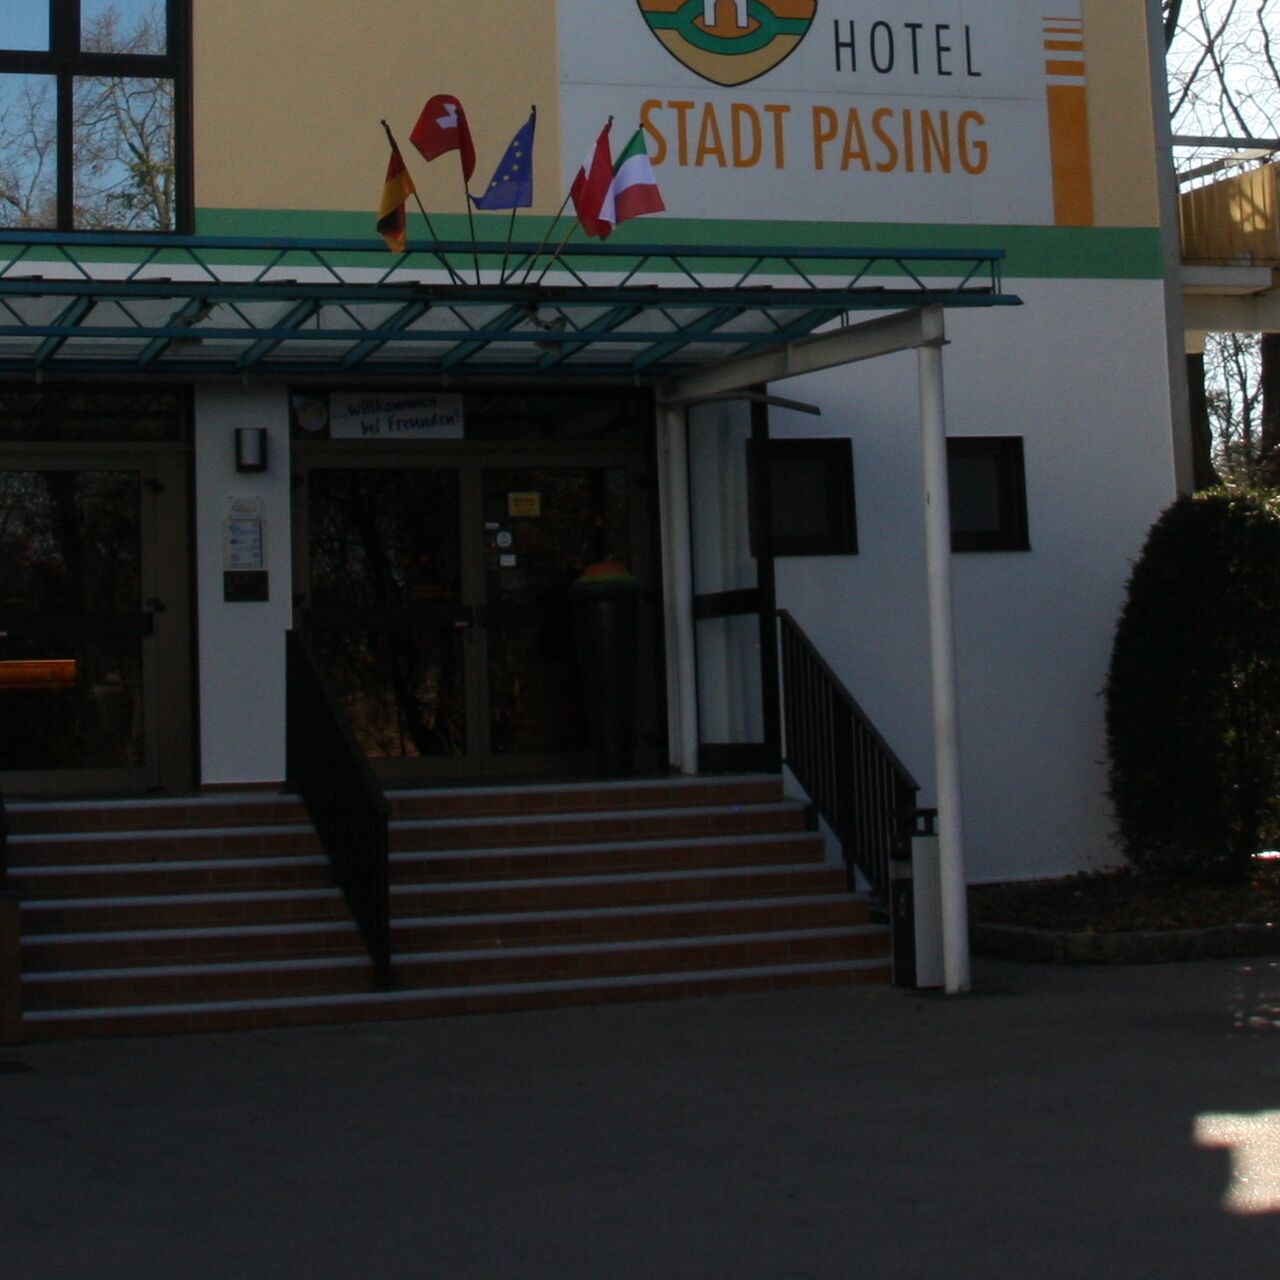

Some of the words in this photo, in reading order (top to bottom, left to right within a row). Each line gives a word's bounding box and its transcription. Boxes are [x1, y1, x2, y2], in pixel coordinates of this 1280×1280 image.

[833, 19, 982, 77] HOTEL
[639, 99, 791, 170] STADT
[812, 106, 989, 175] PASING
